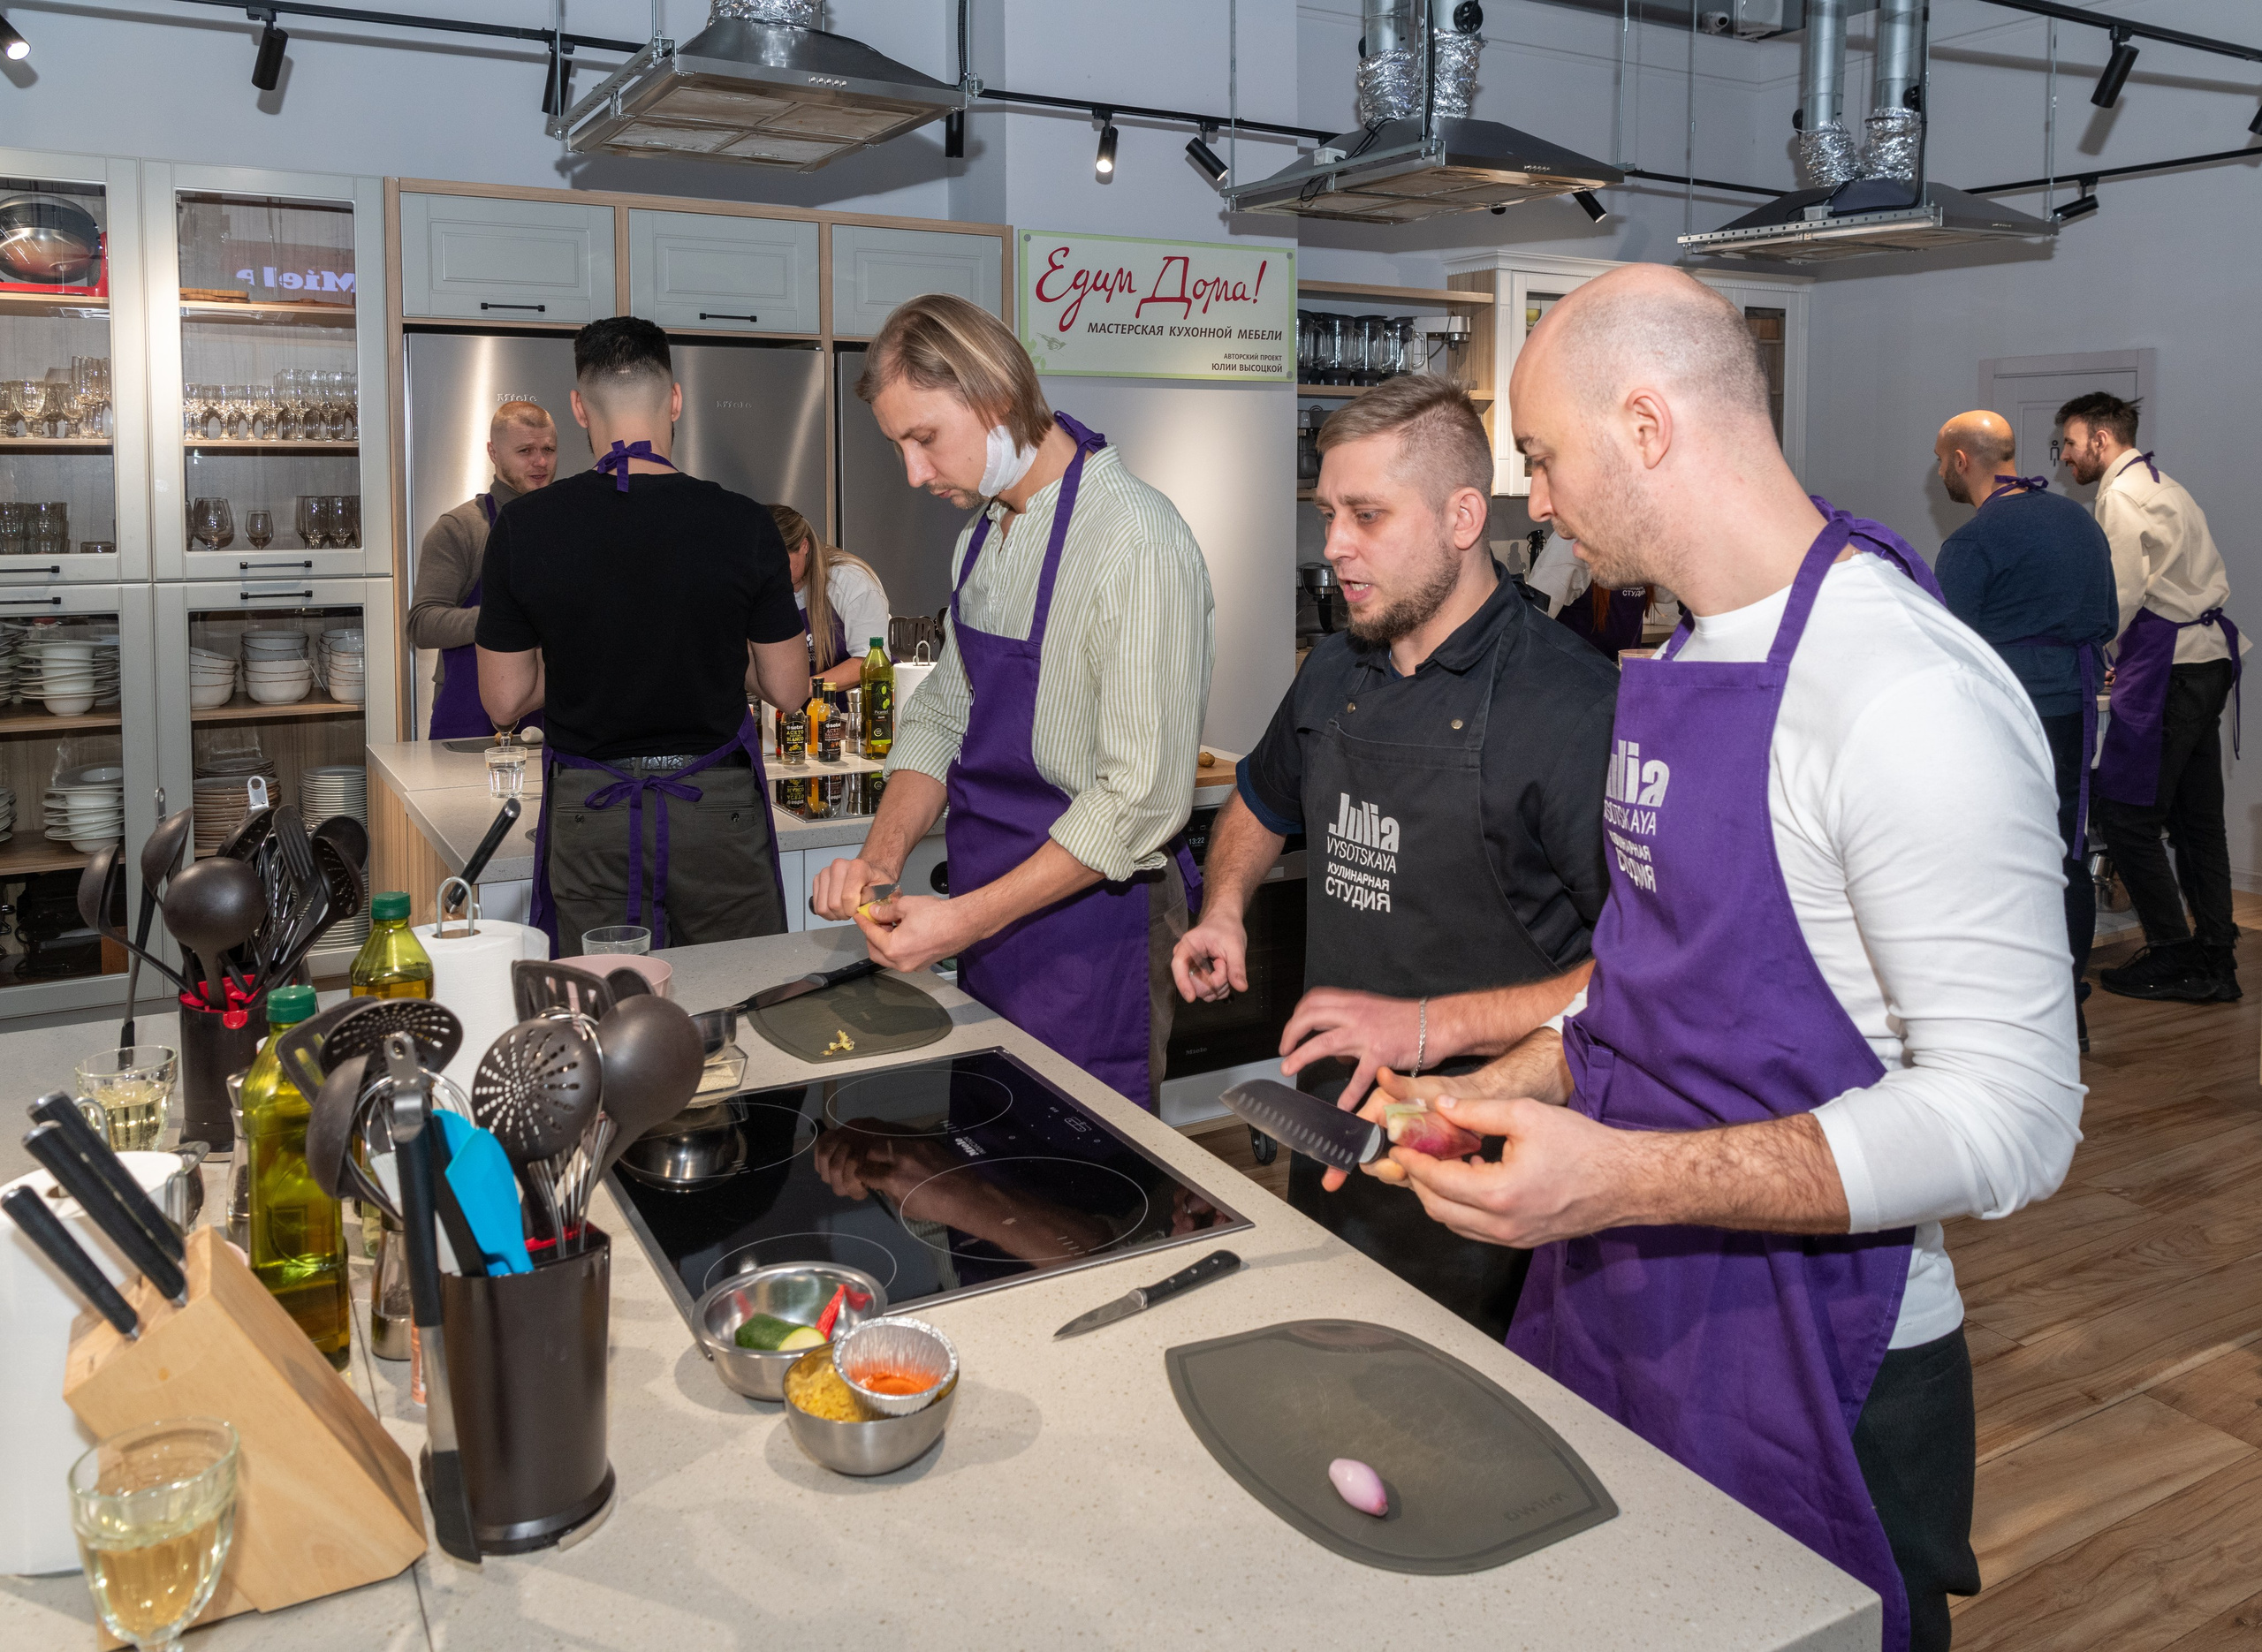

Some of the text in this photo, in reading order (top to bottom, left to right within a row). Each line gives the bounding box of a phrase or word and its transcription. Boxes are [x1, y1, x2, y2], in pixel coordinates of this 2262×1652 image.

[1036, 246, 1267, 332] Едим Дома!
[1087, 322, 1282, 341] МАСТЕРСКАЯ КУХОННОЙ МЕБЕЛИ
[1211, 363, 1282, 373] ЮЛИИ ВЫСОЦКОЙ
[1224, 352, 1259, 361] АВТОРСКИЙ
[1622, 588, 1646, 597] СТУД
[1605, 739, 1670, 807] ulia
[1328, 792, 1400, 853] Julia
[1604, 799, 1656, 836] SOTSKAYA
[1327, 836, 1396, 874] VYSOTSKAYA
[1325, 876, 1391, 913] СТУДИЯ
[1327, 861, 1390, 891] КУЛИНАРНАЯ
